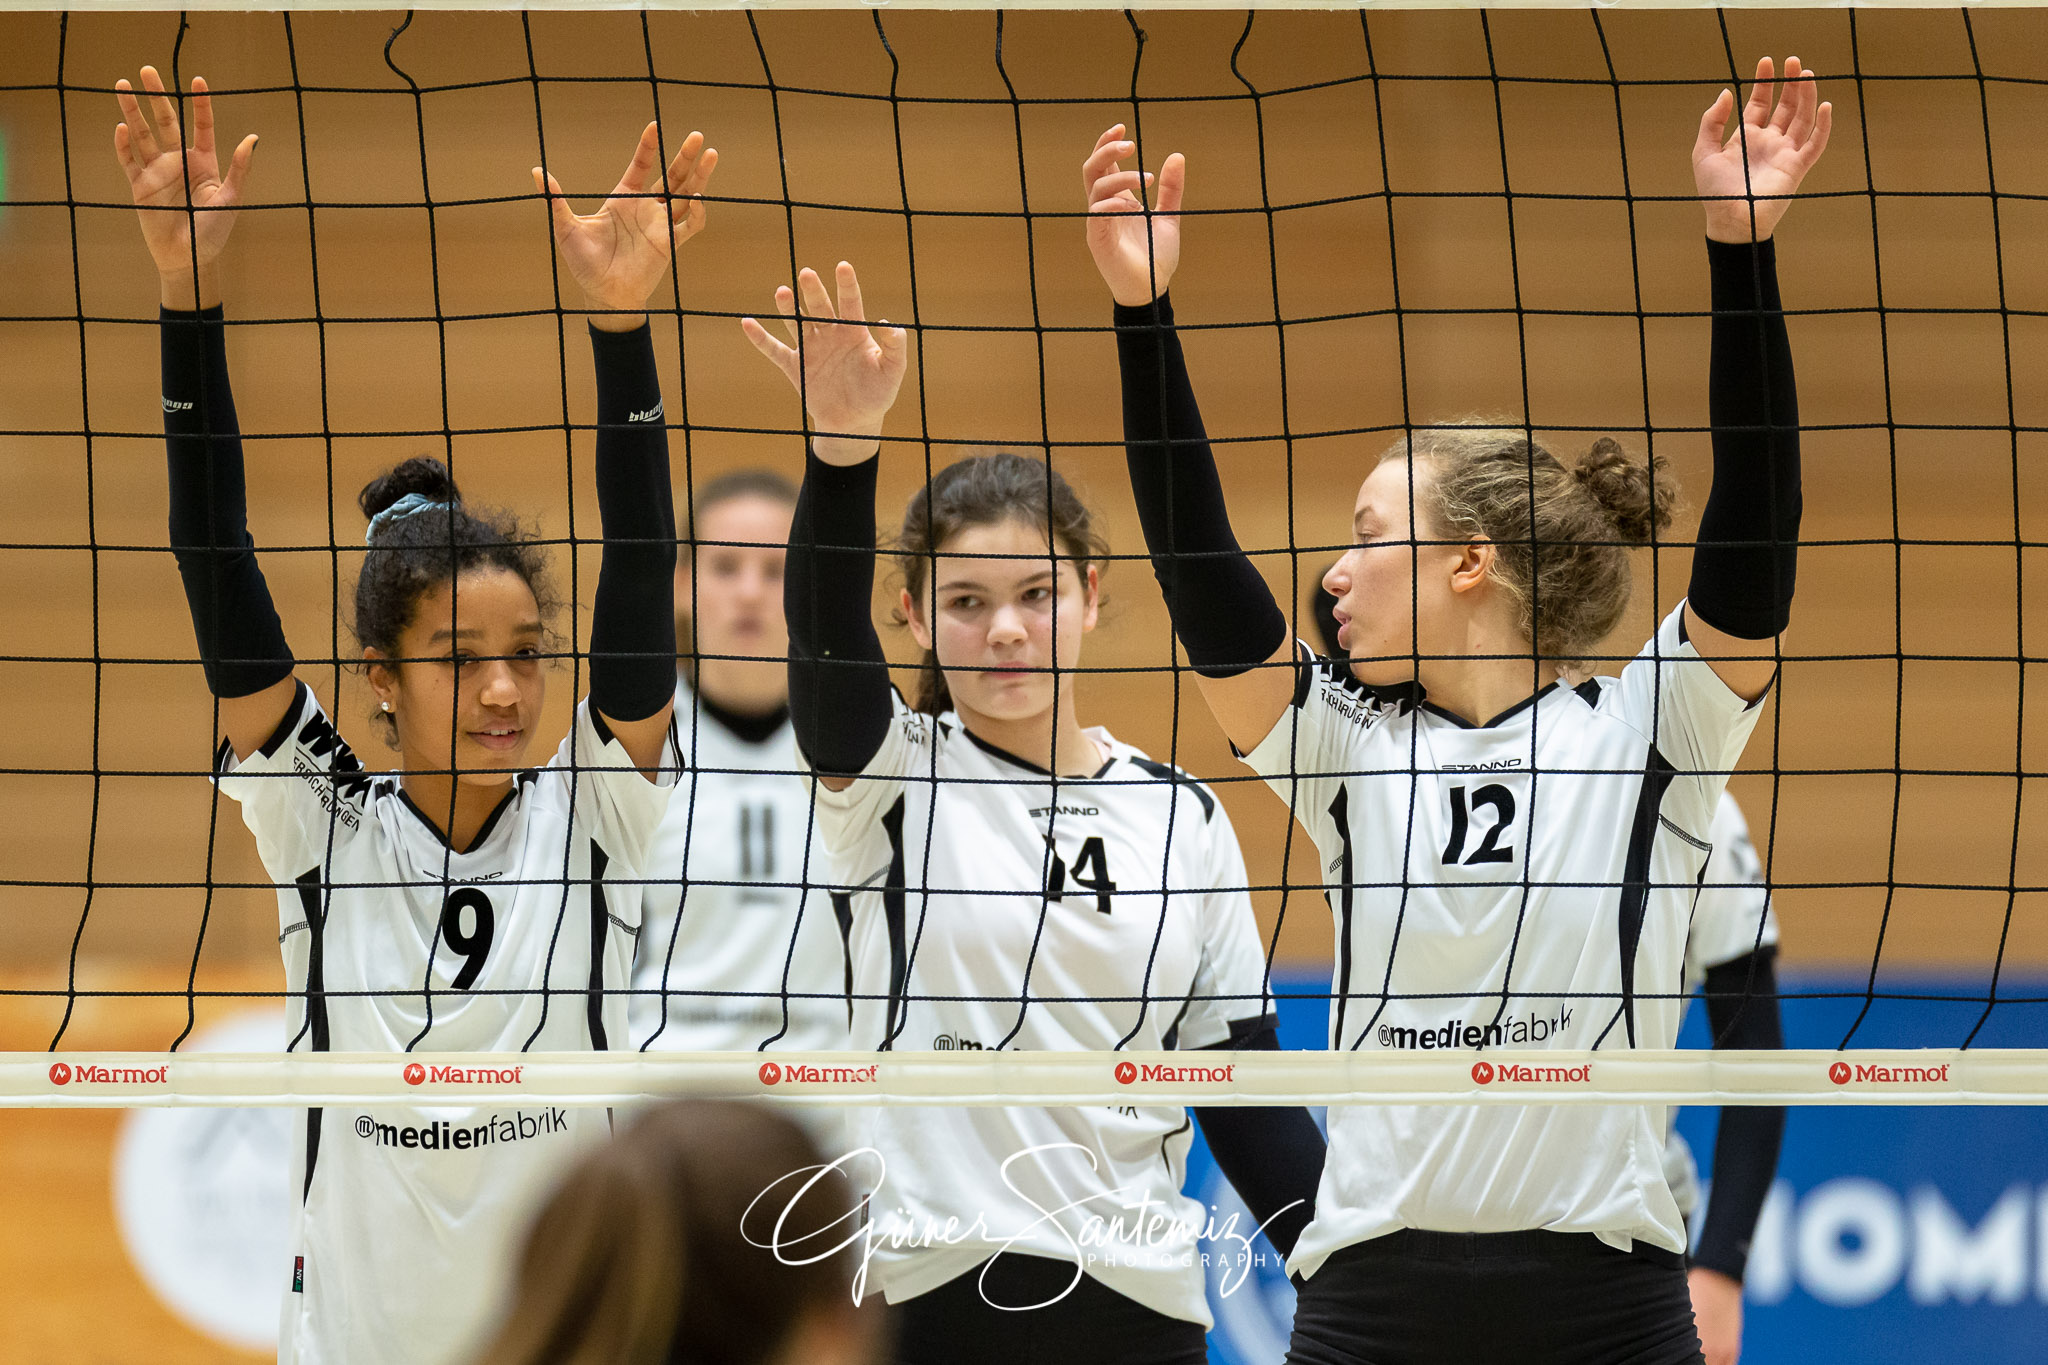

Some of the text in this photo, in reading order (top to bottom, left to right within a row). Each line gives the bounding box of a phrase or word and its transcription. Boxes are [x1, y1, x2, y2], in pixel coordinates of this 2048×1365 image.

[1441, 783, 1516, 866] 12
[1041, 833, 1117, 915] 14
[442, 887, 495, 990] 9
[75, 1065, 168, 1083] Marmot
[429, 1065, 523, 1083] Marmot
[784, 1065, 879, 1083] Marmot
[1140, 1065, 1233, 1083] Marmot
[1497, 1065, 1592, 1083] Marmot
[1854, 1065, 1950, 1083] Marmot
[375, 1106, 568, 1150] medienfabrik
